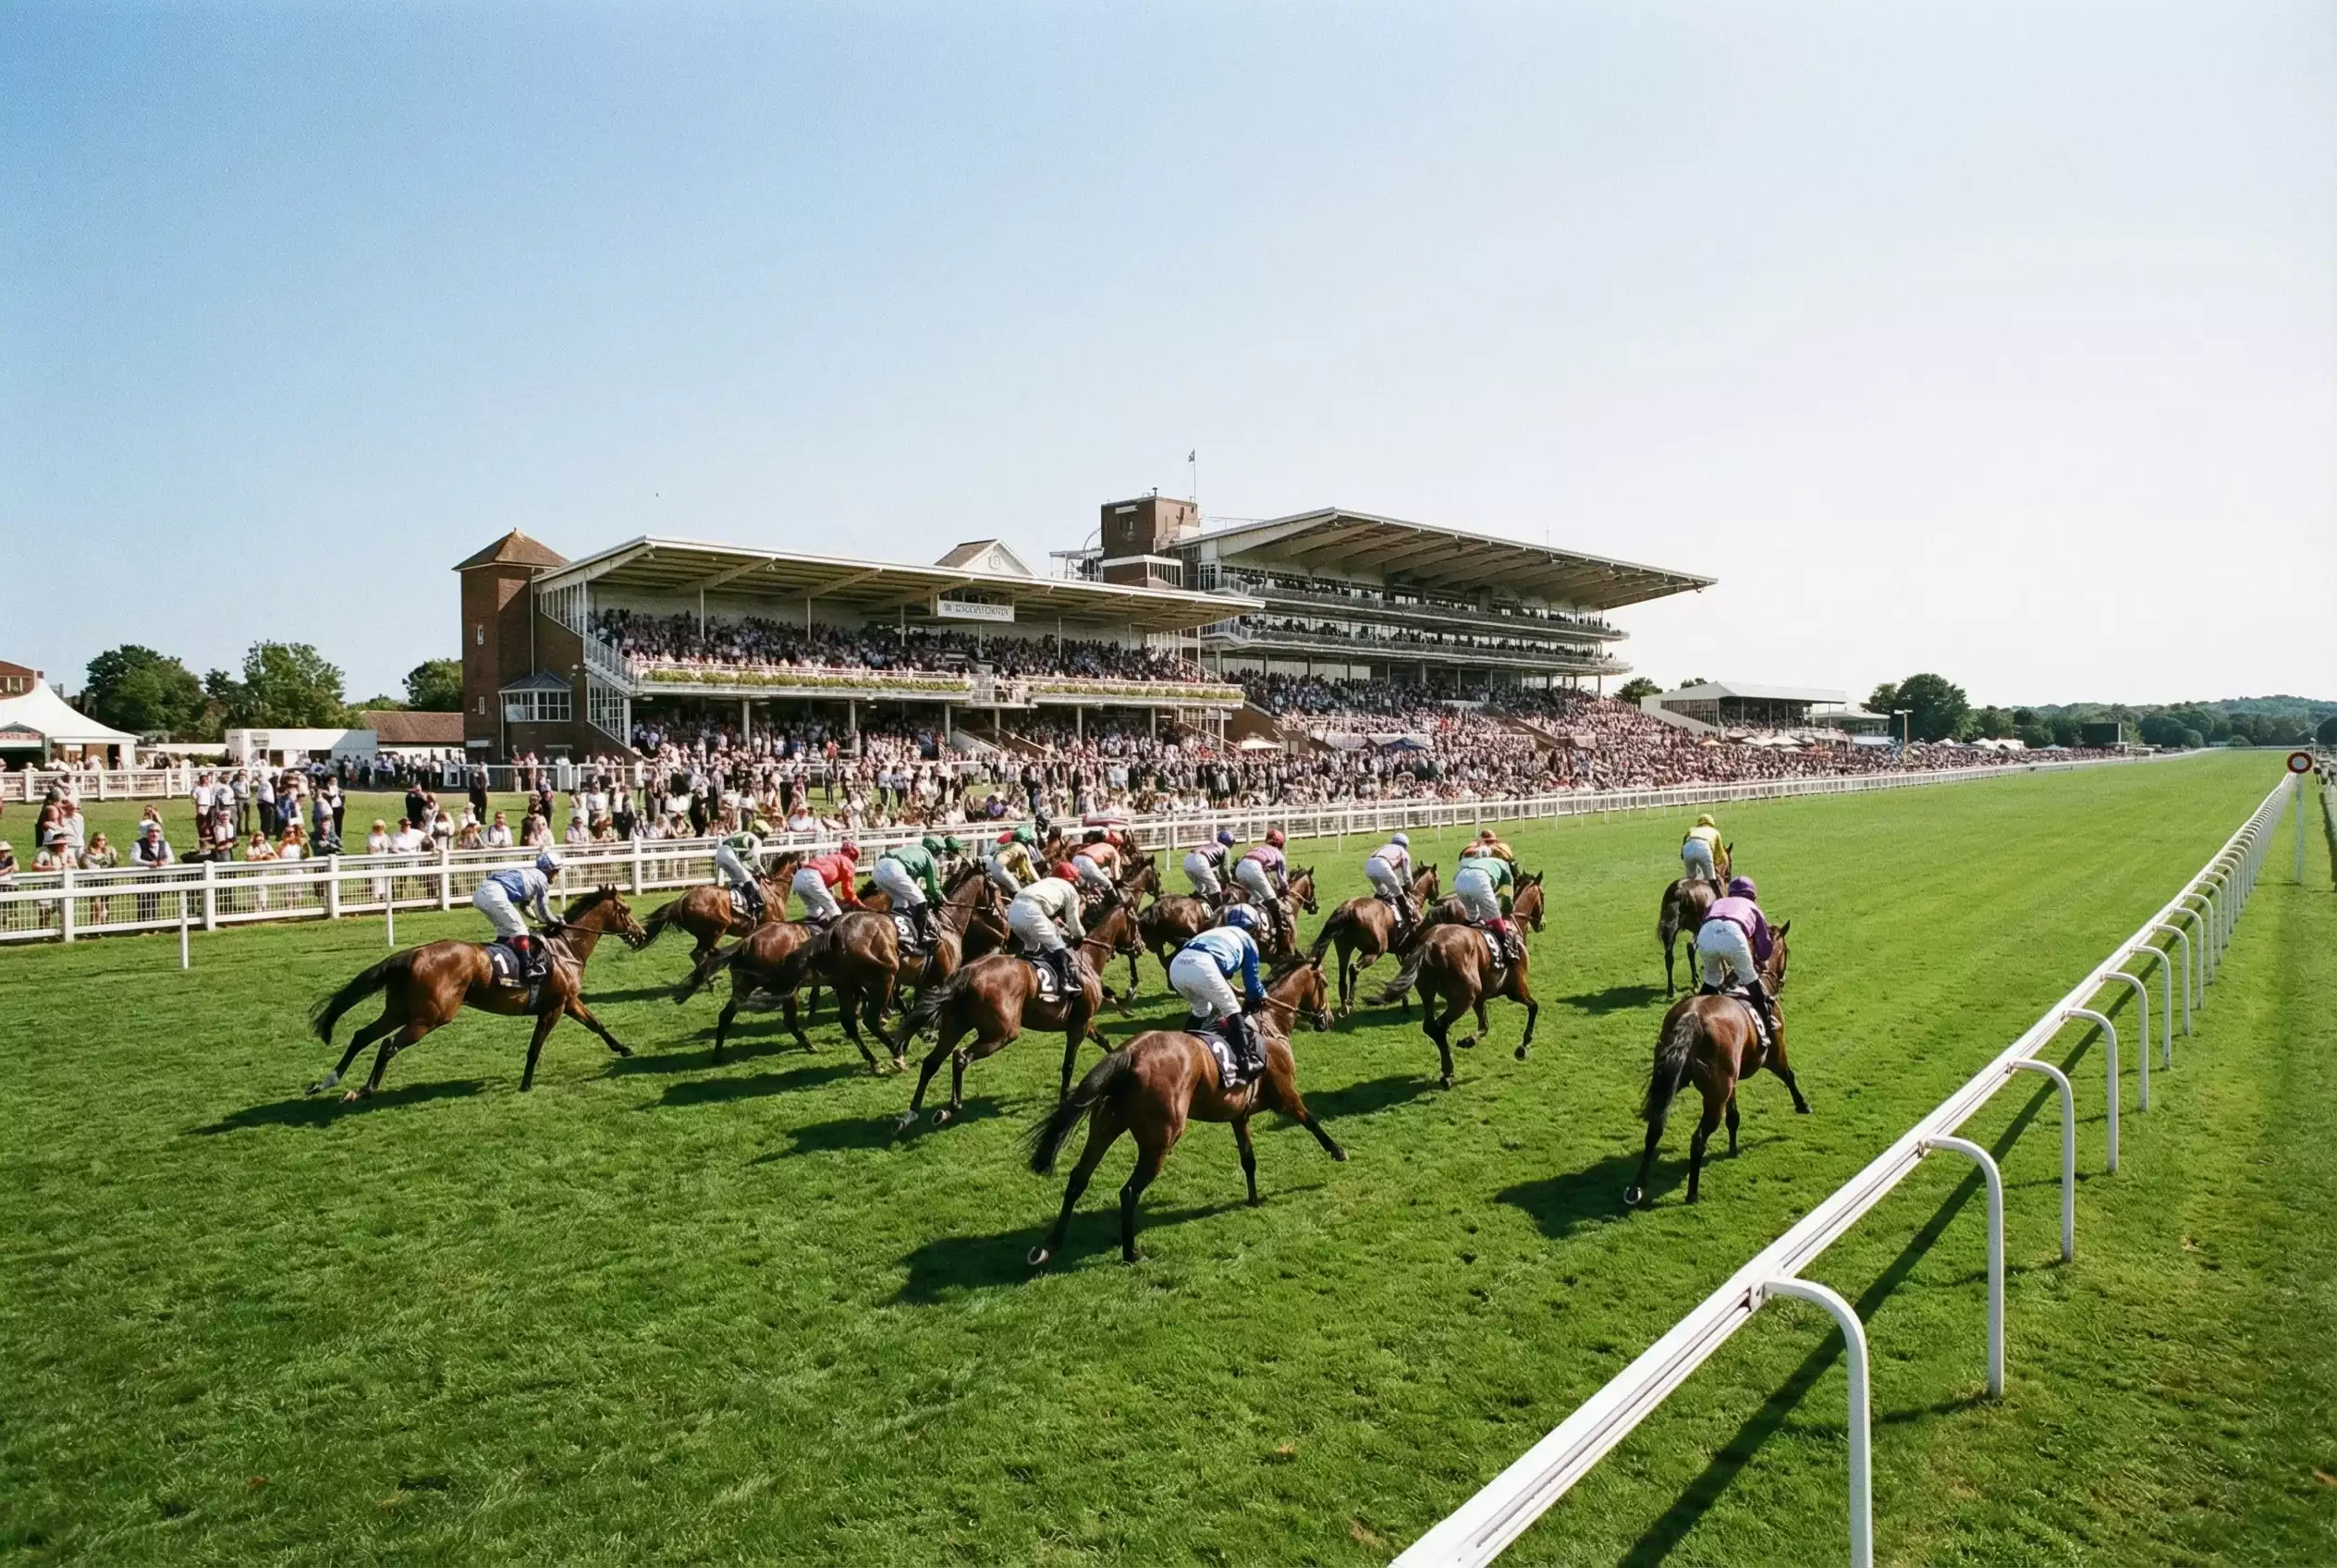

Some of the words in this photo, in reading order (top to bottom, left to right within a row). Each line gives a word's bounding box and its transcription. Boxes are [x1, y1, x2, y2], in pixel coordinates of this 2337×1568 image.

[894, 915, 910, 936] 8
[494, 953, 509, 974] 1
[1036, 967, 1053, 992] 2
